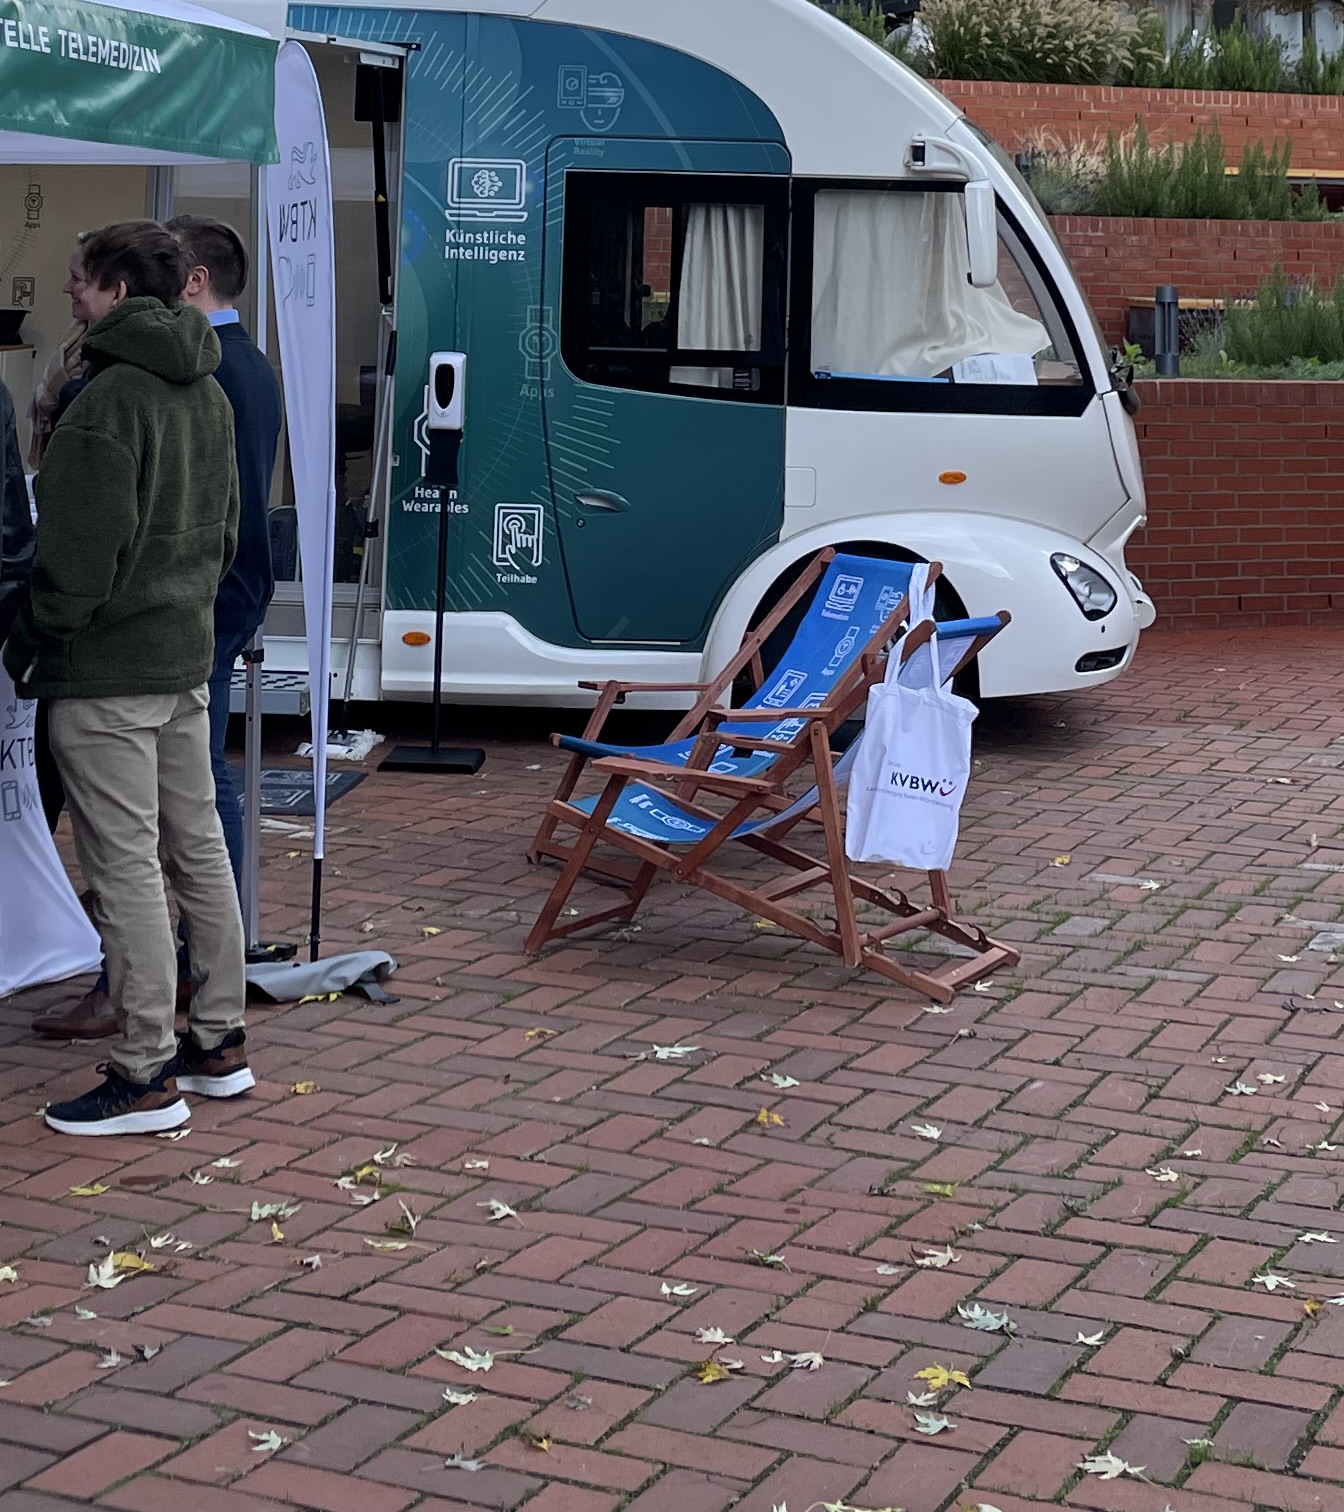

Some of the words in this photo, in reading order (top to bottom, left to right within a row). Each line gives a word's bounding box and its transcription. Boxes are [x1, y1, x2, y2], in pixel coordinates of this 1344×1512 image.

[57, 29, 162, 74] TELEMEDIZIN
[445, 229, 526, 245] Künstliche
[444, 245, 526, 264] Intelligenz
[496, 573, 538, 584] Teilhabe
[890, 771, 940, 794] KVBW
